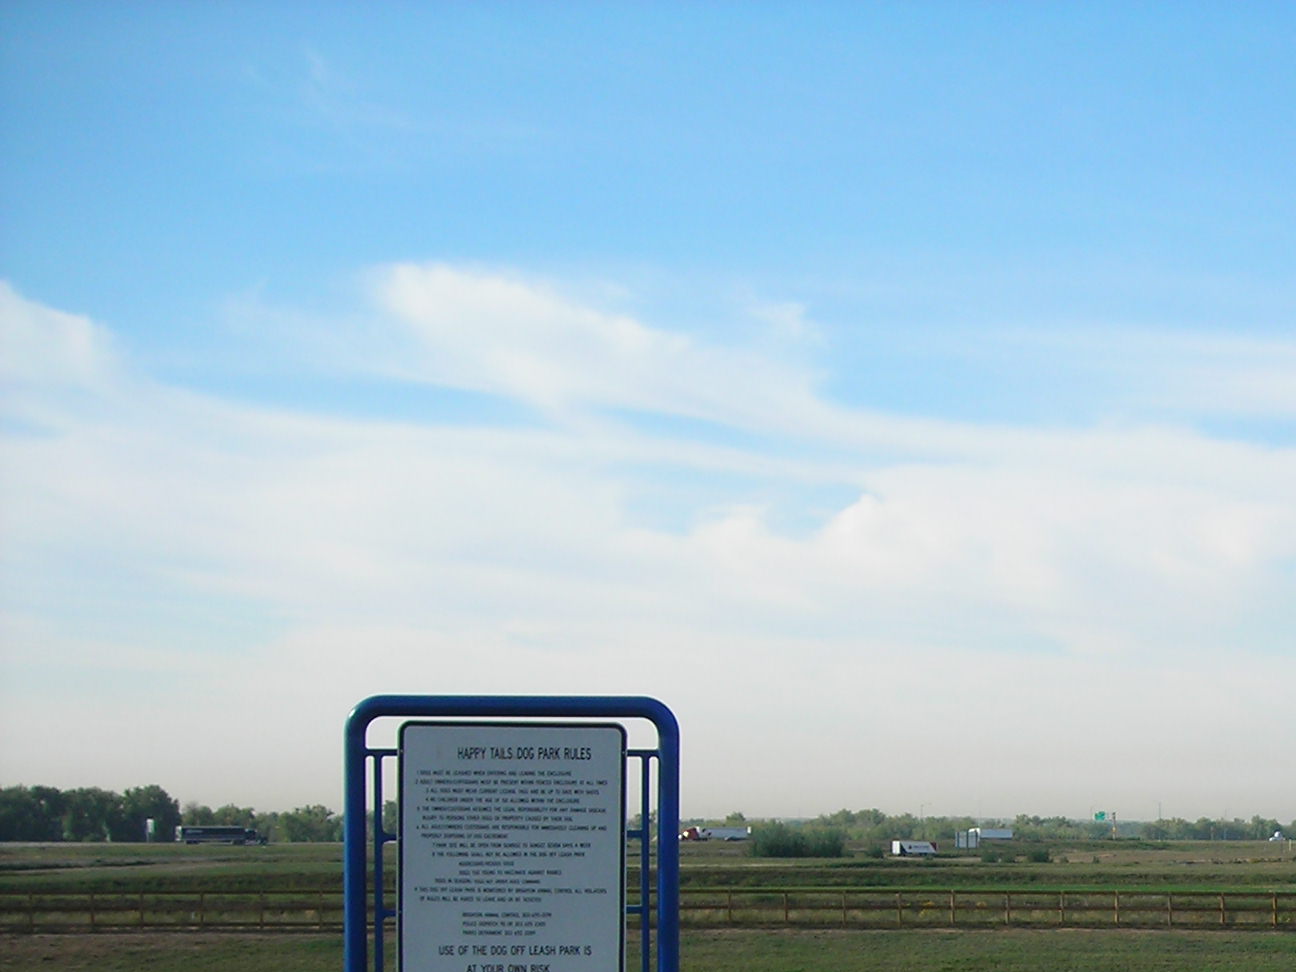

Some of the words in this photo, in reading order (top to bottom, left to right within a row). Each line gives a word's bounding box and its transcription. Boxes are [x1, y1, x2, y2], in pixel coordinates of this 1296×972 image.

[457, 747, 486, 759] HAPPY
[490, 747, 513, 759] TAILS
[516, 747, 534, 760] DOG
[538, 747, 560, 760] PARK
[564, 747, 591, 760] RULES
[438, 945, 454, 956] USE
[458, 945, 469, 955] OF
[472, 945, 487, 955] THE
[490, 945, 507, 956] DOG
[510, 945, 526, 955] OFF
[529, 945, 556, 956] LEASH
[559, 945, 580, 955] PARK
[584, 946, 592, 956] IS
